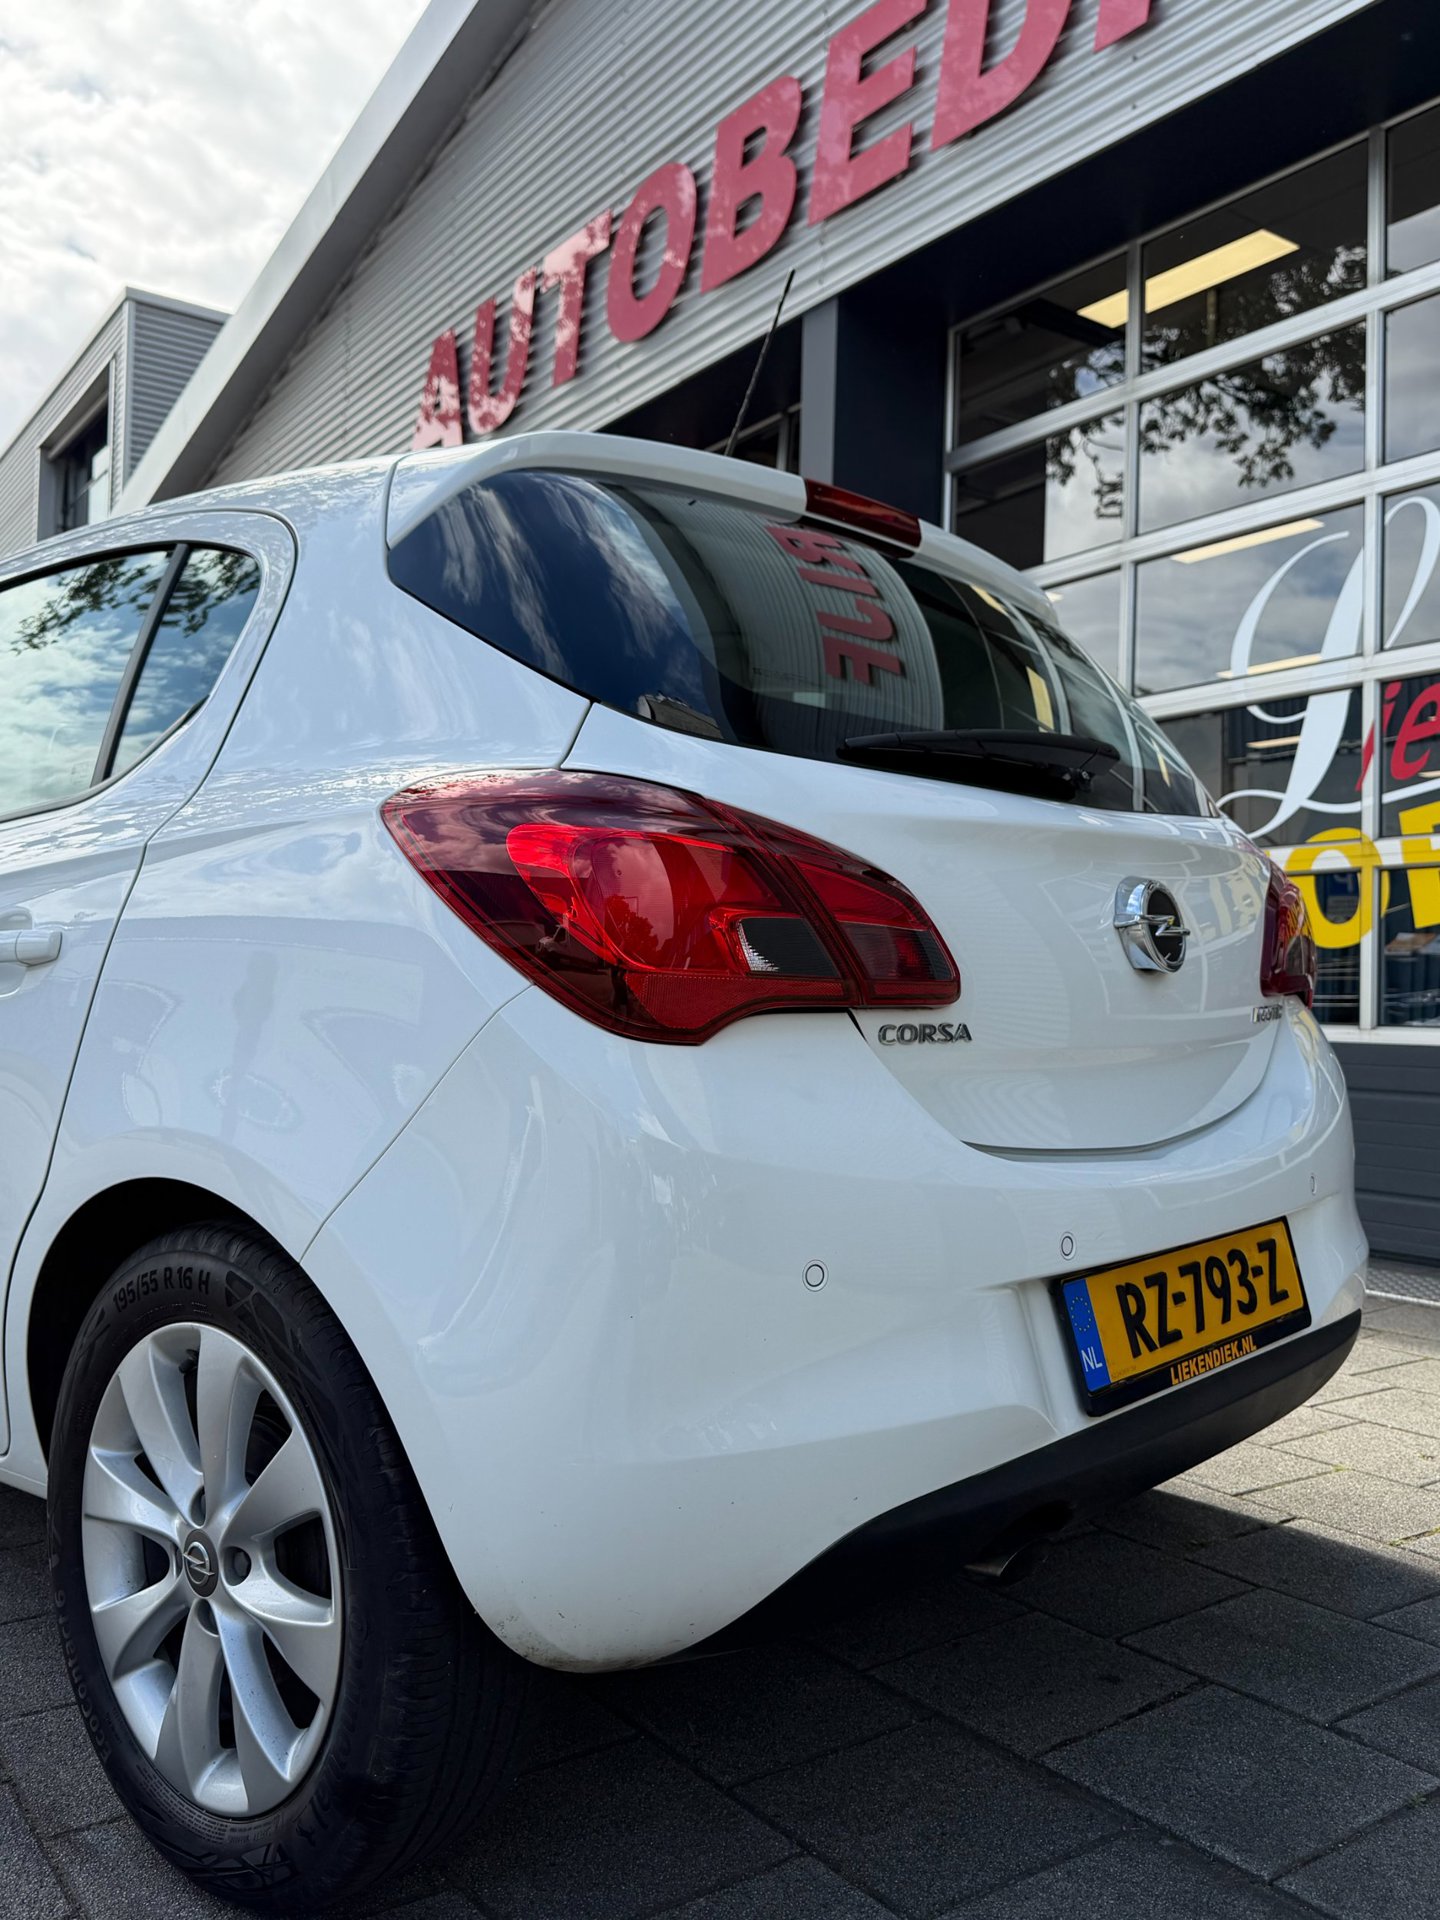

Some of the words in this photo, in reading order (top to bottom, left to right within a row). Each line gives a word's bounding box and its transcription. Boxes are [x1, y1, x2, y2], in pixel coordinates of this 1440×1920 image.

[411, 0, 1150, 450] AUTOBED
[878, 1022, 972, 1045] CORSA
[112, 1270, 158, 1312] 195/55
[163, 1267, 174, 1289] R
[176, 1266, 193, 1290] 16
[199, 1271, 210, 1294] H
[1115, 1237, 1290, 1359] RZ-793-Z
[1081, 1347, 1103, 1372] NL
[1170, 1335, 1257, 1385] LIEKENDIEK.NL
[54, 1589, 67, 1608] 6
[58, 1614, 112, 1763] EcoContact
